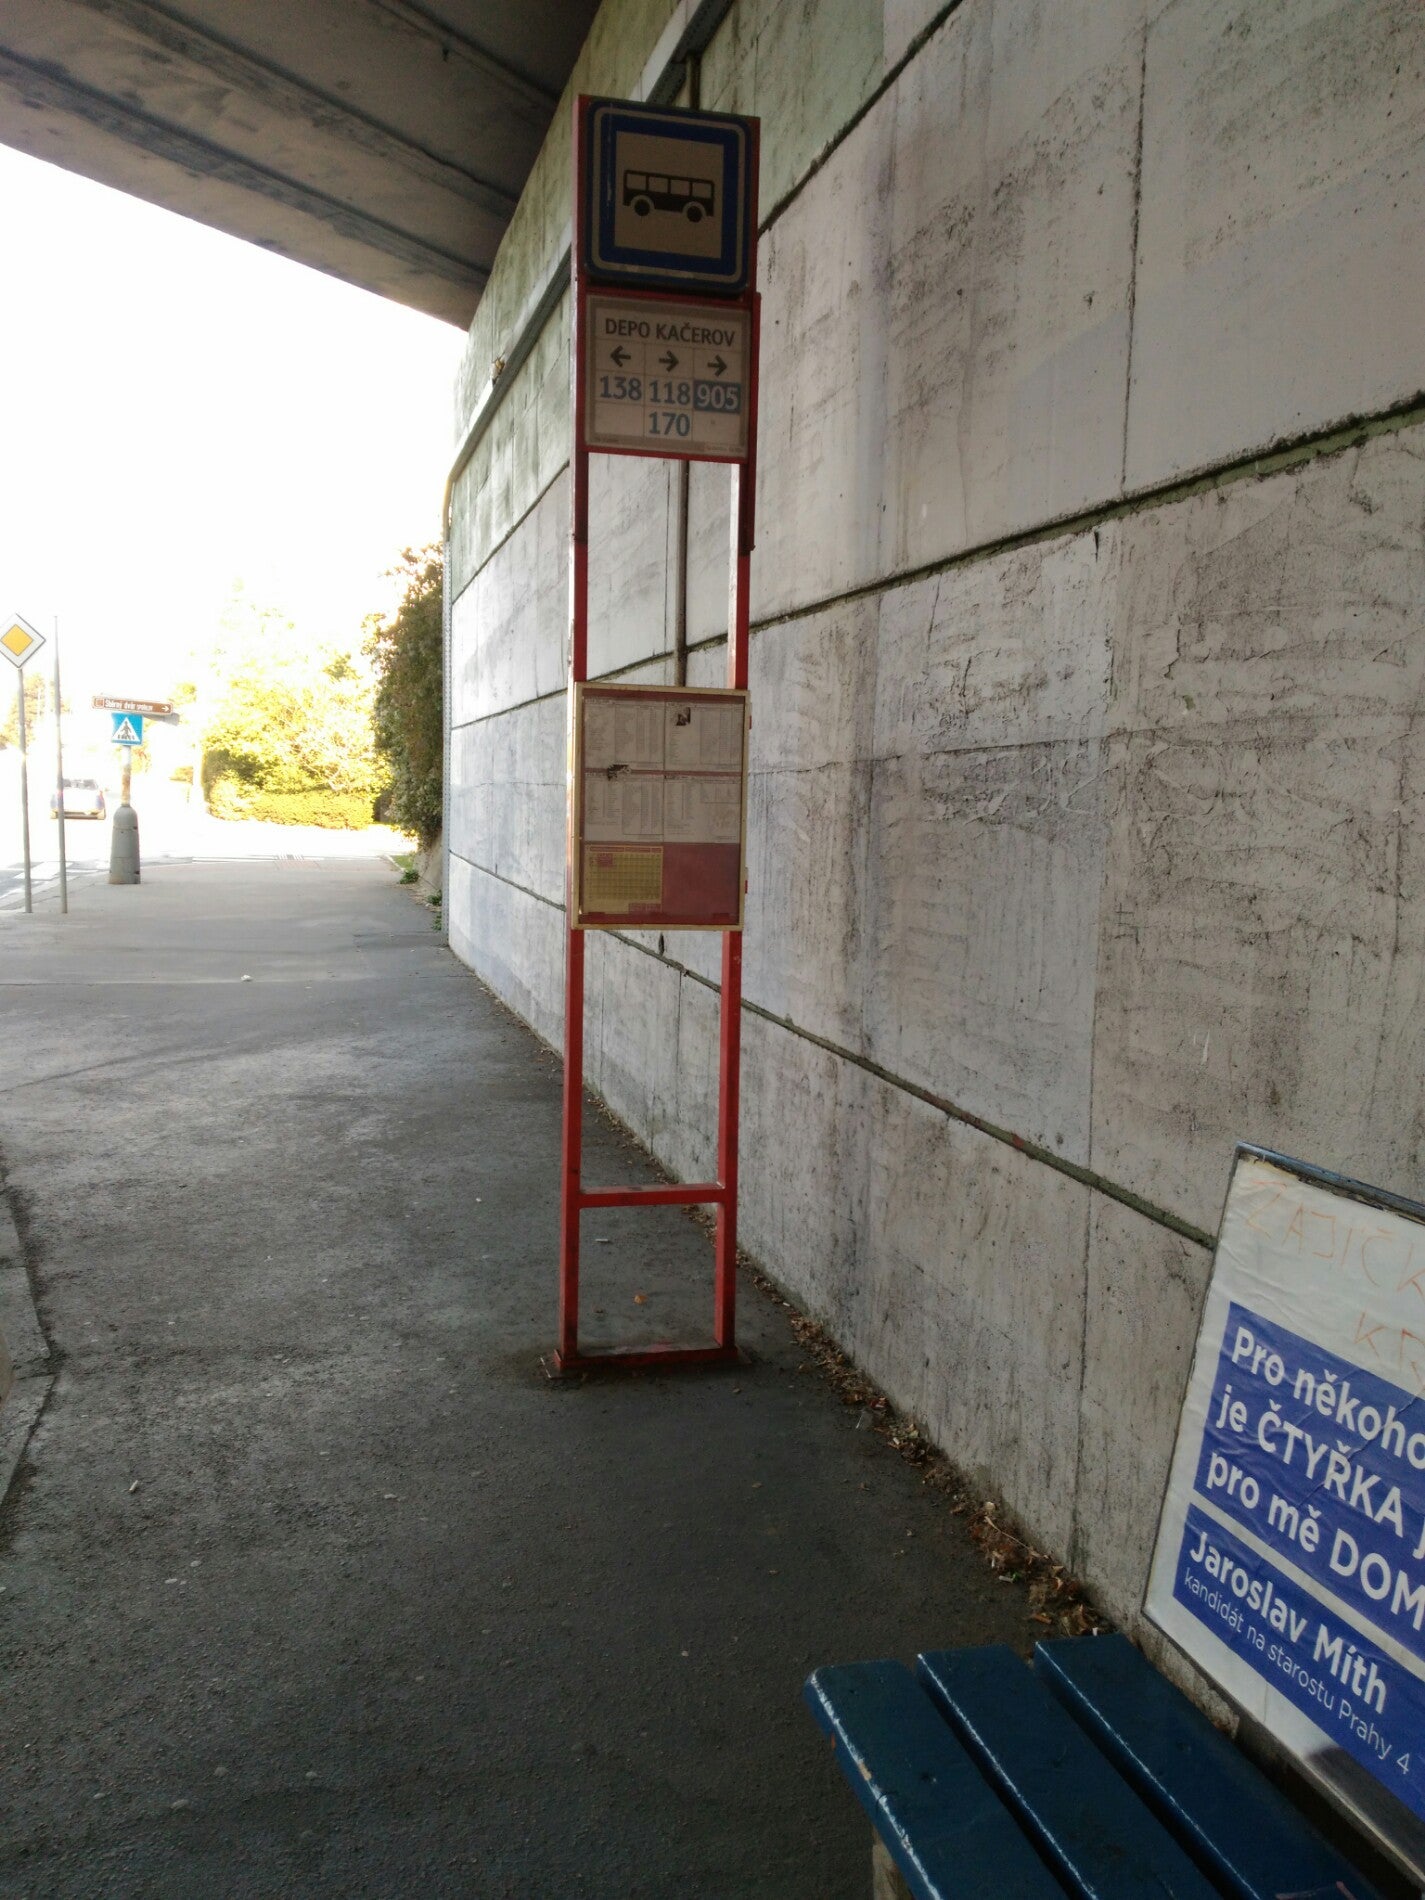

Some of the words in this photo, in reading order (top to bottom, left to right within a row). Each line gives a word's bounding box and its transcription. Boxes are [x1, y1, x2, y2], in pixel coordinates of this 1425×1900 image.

[600, 375, 642, 401] 138
[649, 379, 690, 406] 118
[696, 384, 738, 411] 905
[605, 318, 650, 338] DEPO
[655, 322, 735, 347] KAČEROV
[649, 411, 690, 437] 170
[1215, 1384, 1248, 1433] je
[1257, 1398, 1404, 1538] ČTYŘKA
[1231, 1326, 1285, 1386] Pro
[1294, 1368, 1425, 1470] někoho
[1189, 1531, 1307, 1643] Jaroslav
[1206, 1452, 1260, 1510] pro
[1267, 1494, 1320, 1553] mě
[1329, 1528, 1425, 1632] DOM
[1184, 1567, 1245, 1634] kandidát
[1246, 1623, 1265, 1651] na
[1267, 1642, 1334, 1710] starostu
[1338, 1699, 1392, 1760] Prahy
[1395, 1752, 1410, 1775] 4
